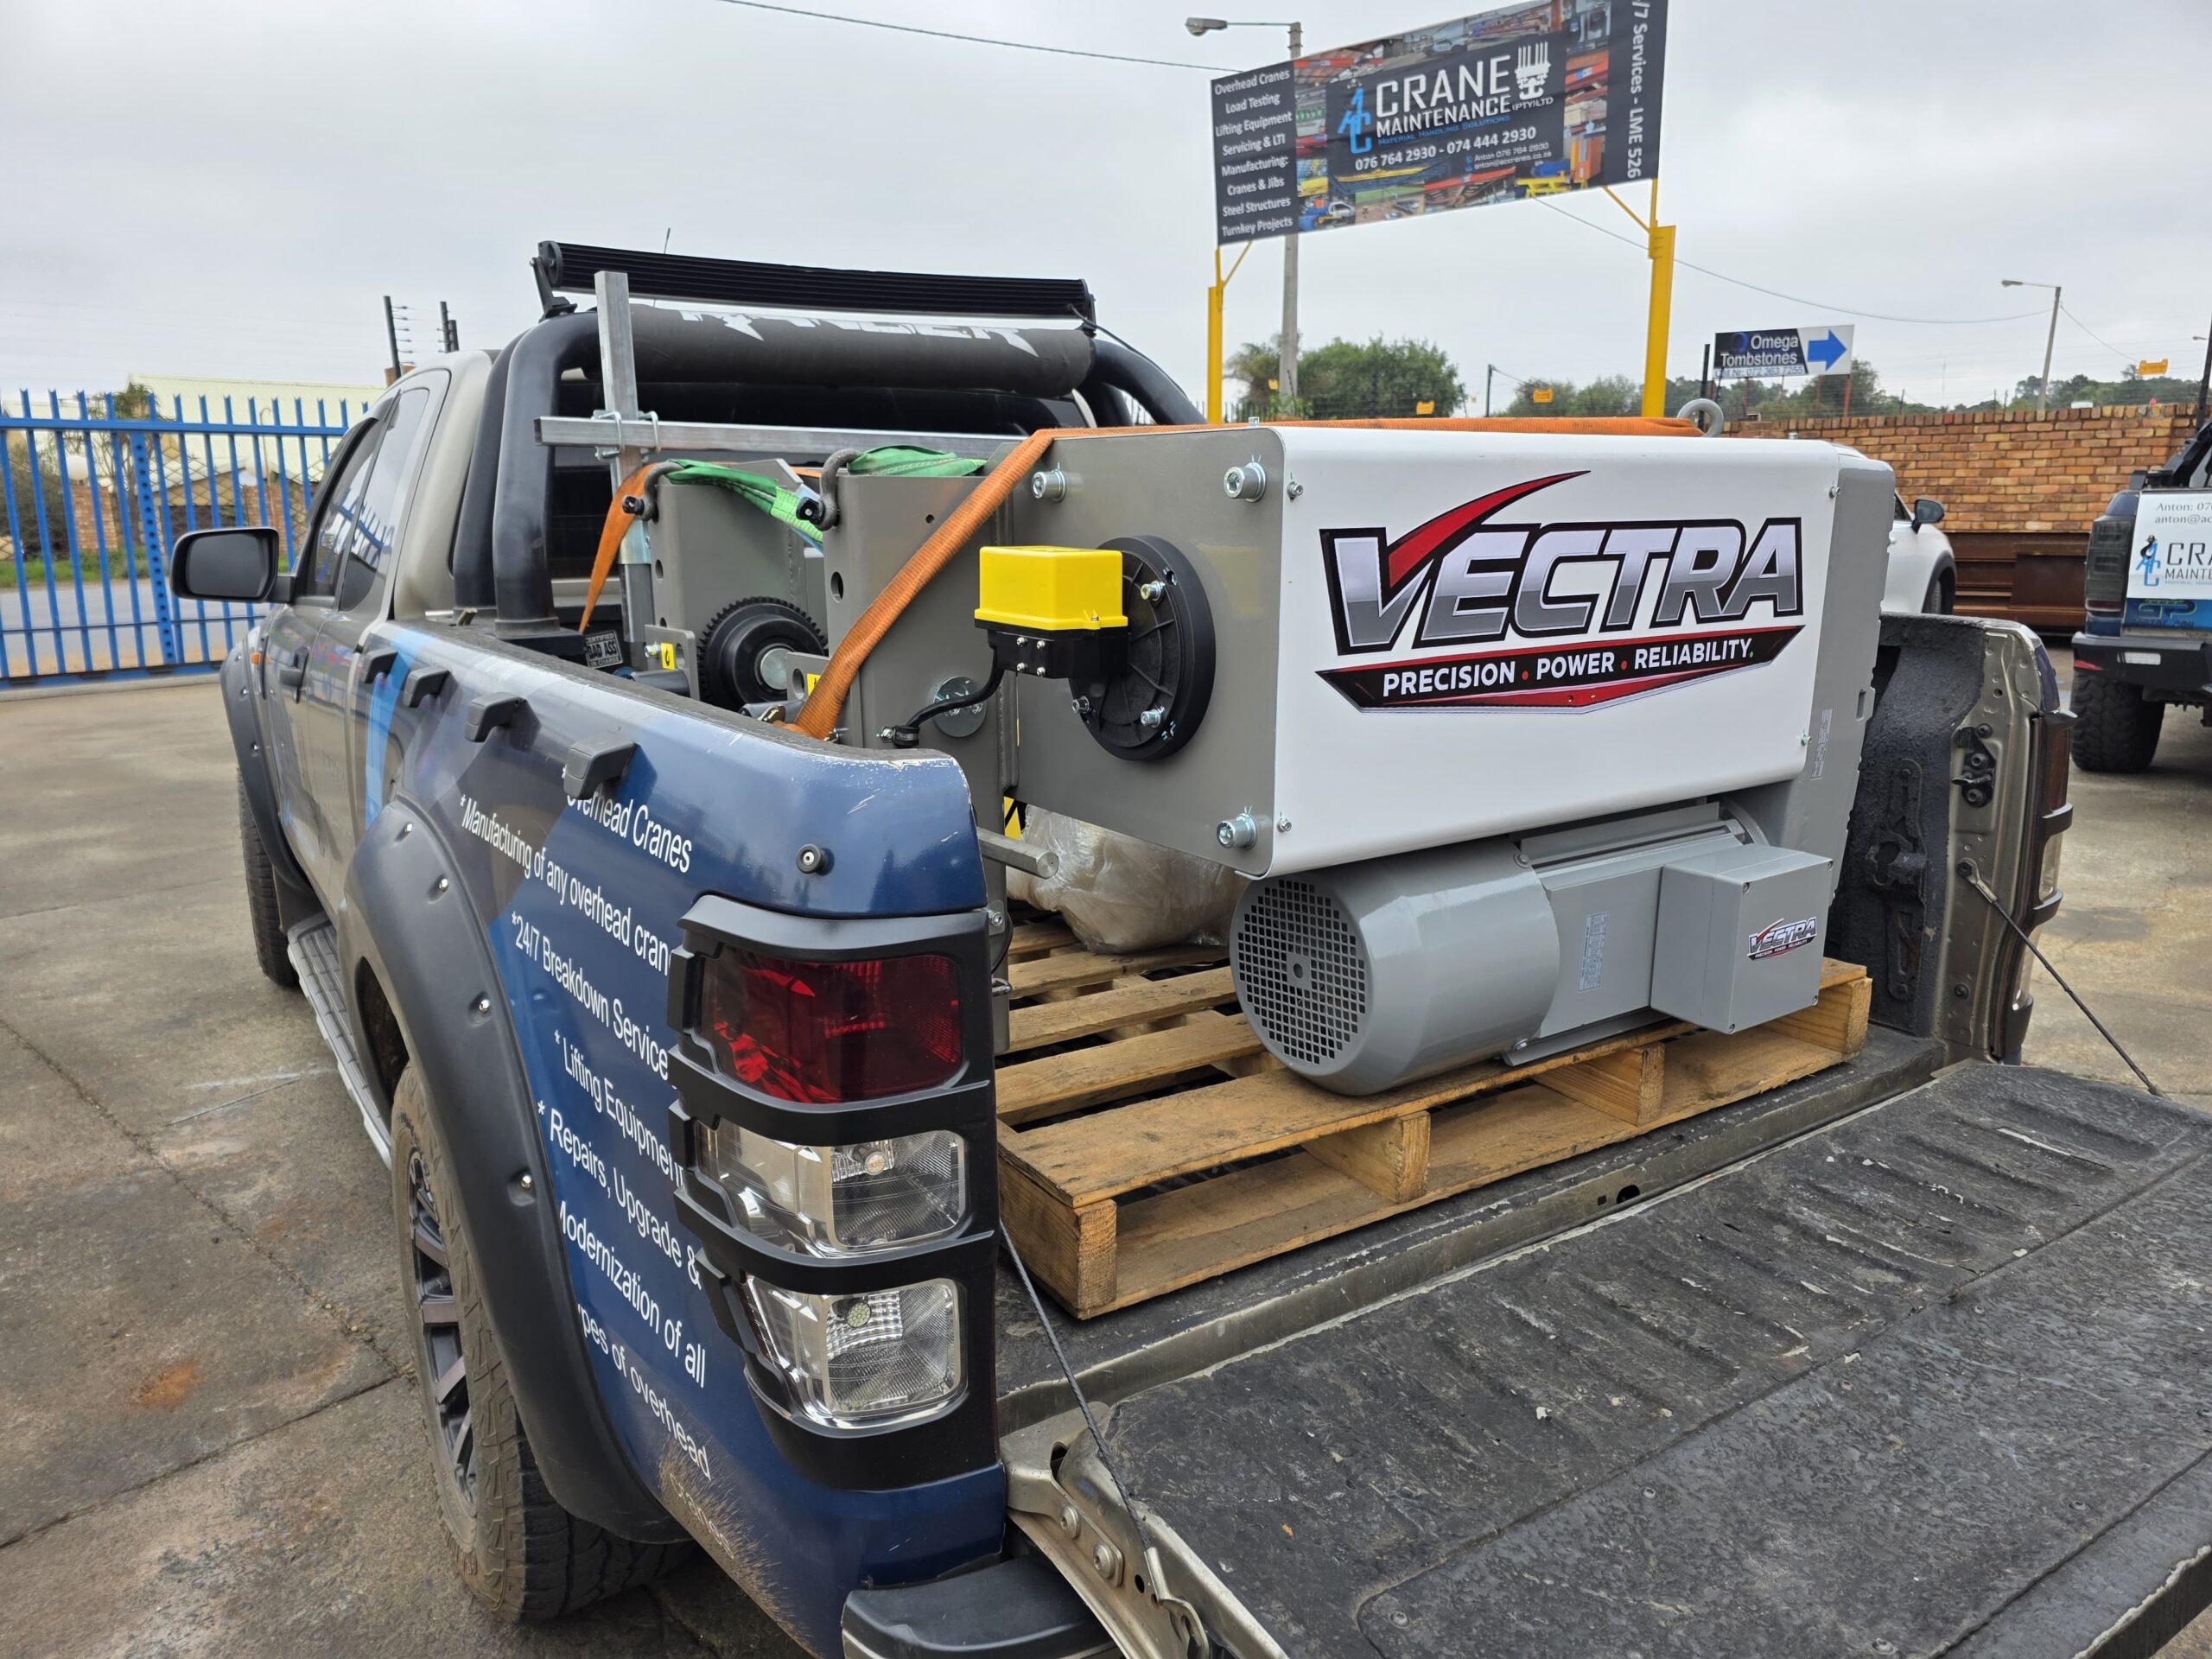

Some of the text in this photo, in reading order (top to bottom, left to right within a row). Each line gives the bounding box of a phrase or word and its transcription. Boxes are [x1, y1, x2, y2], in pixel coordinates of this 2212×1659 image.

[1632, 0, 1650, 18] /7
[1630, 22, 1649, 94] Services
[1214, 69, 1291, 95] Overhead Cranes
[1376, 54, 1511, 118] CRANE
[1225, 93, 1281, 114] Load Testing
[1376, 93, 1512, 138] MAINTENANCE
[1215, 111, 1293, 137] Lifting Equipment
[1629, 108, 1644, 144] LME
[1223, 133, 1287, 156] Servicing & LTI
[1354, 157, 1378, 171] 076
[1380, 152, 1402, 167] 764
[1405, 145, 1437, 162] 2930
[1446, 138, 1471, 155] 074
[1473, 132, 1499, 149] 444
[1502, 125, 1537, 144] 2930
[1627, 149, 1643, 179] 526
[1227, 175, 1286, 196] Cranes & Jibs
[1223, 197, 1292, 217] Steel Structures
[1221, 216, 1294, 237] Turnkey Projects
[1719, 352, 1798, 367] Tombstones
[1751, 334, 1798, 352] Omega
[2156, 502, 2193, 512] Anton:
[1319, 472, 1804, 656] VECTRA
[1382, 661, 1516, 697] PRECISION
[1536, 652, 1614, 681] POWER
[632, 804, 692, 874] Cranes
[534, 847, 547, 880] of
[547, 861, 569, 906] any
[570, 877, 632, 947] overhead
[634, 925, 671, 977] cran
[1749, 918, 1817, 955] VECTRA
[543, 936, 610, 1028] Breakdown
[563, 1037, 603, 1114] Lifting
[550, 1108, 702, 1291] Repairs, Upgrade &
[664, 1319, 683, 1358] of
[684, 1343, 707, 1389] all
[612, 1344, 627, 1378] of
[631, 1366, 712, 1482] overhead
